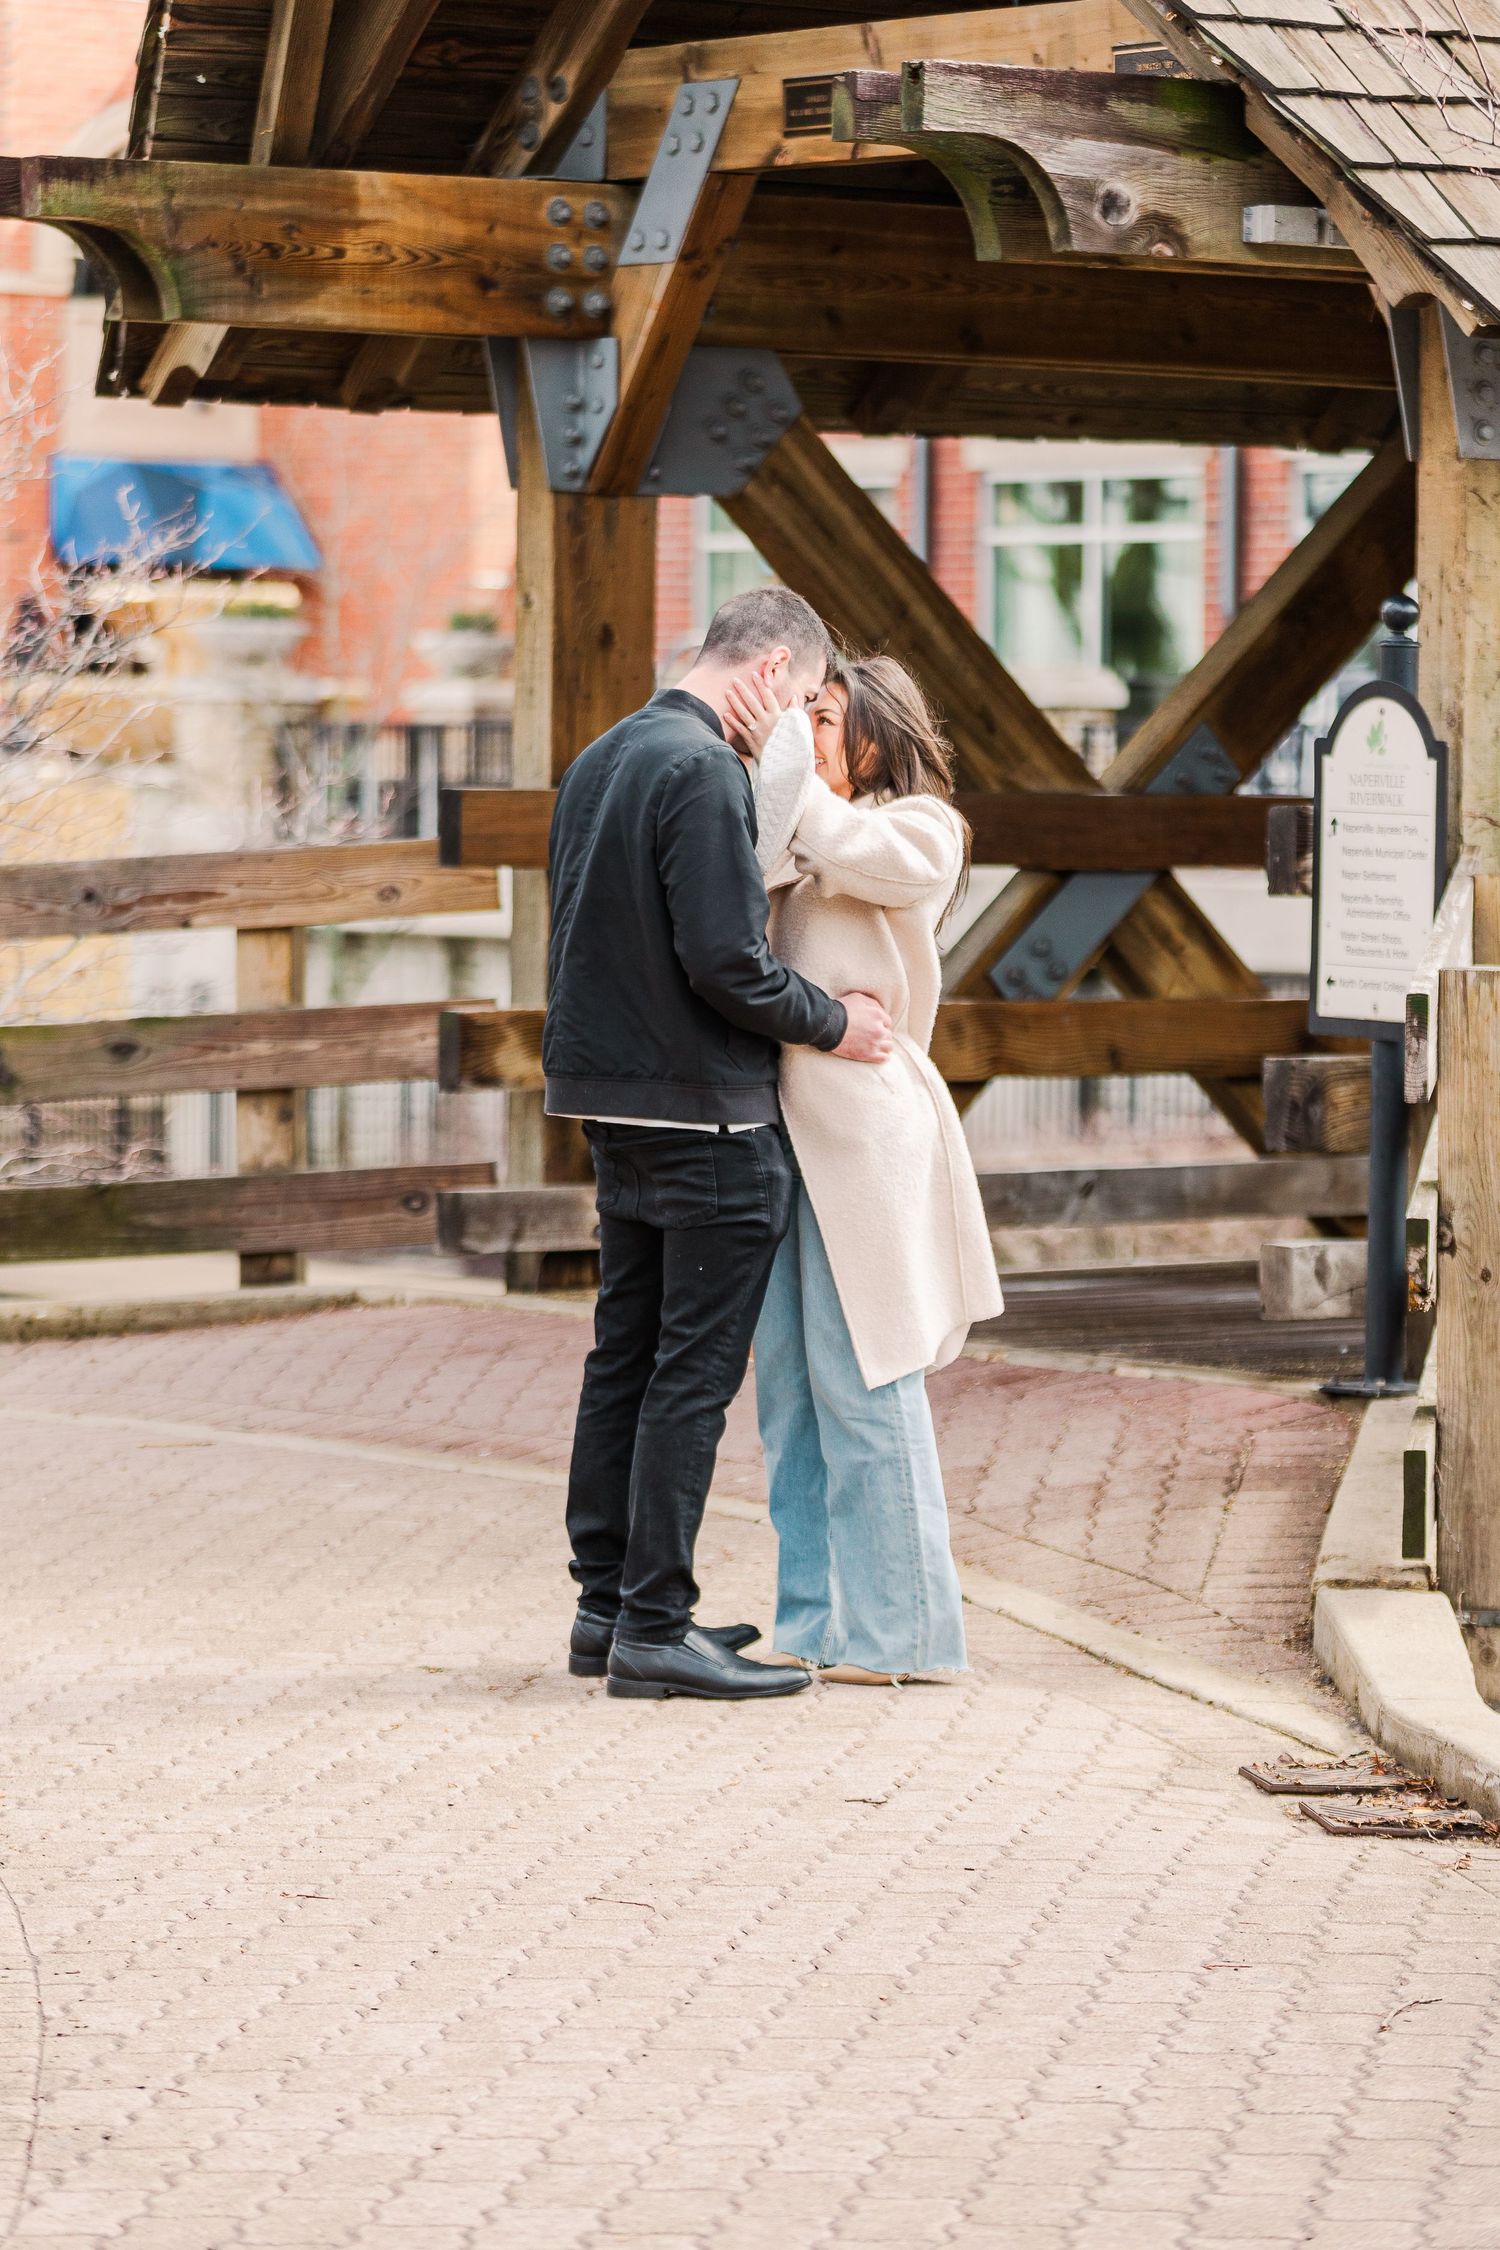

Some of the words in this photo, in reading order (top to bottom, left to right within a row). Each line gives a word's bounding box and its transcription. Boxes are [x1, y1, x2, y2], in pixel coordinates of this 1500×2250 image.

[1349, 773, 1406, 788] NAPERVILLE
[1349, 792, 1405, 807] RIVERWALK
[1342, 823, 1374, 834] Naperville
[1342, 846, 1374, 858] Naperville
[1375, 848, 1405, 860] Municipal
[1407, 849, 1428, 860] Center
[1342, 869, 1361, 881] Naper
[1341, 893, 1373, 905] Naperville
